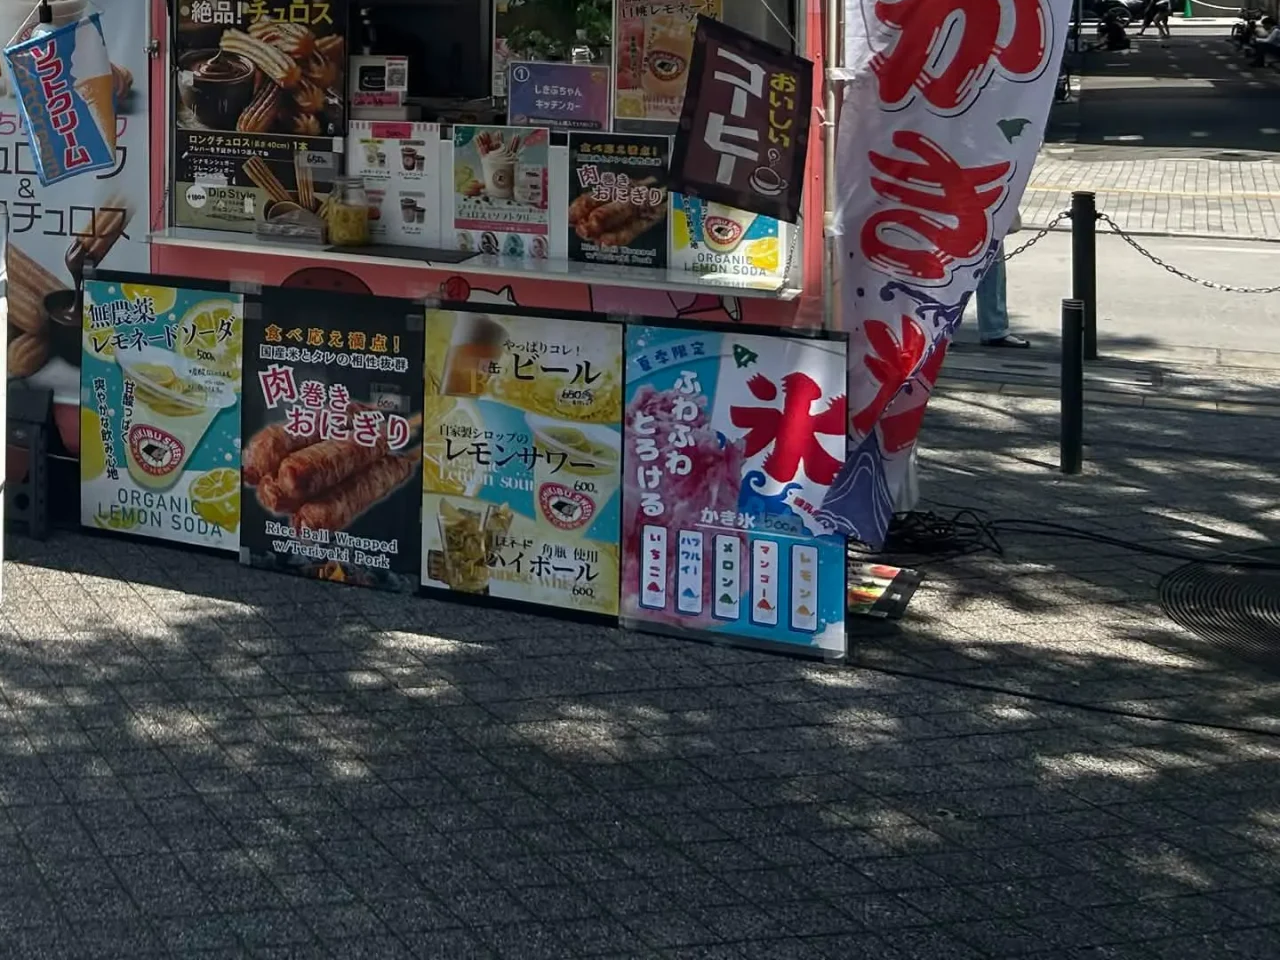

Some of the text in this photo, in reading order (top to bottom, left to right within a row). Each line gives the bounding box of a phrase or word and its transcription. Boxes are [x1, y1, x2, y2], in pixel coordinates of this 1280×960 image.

[30, 39, 92, 170] ソフトクリーム
[534, 85, 582, 96] しきぶちゃん
[536, 100, 581, 111] キッチンカー
[704, 47, 767, 185] コーヒー
[768, 72, 797, 148] おいしい
[18, 178, 35, 198] &
[577, 164, 630, 188] 肉巻き
[592, 186, 663, 206] おにぎり
[684, 262, 766, 276] LEMON SODA
[697, 253, 753, 265] ORGANIC
[89, 298, 156, 329] 無農薬
[92, 316, 237, 354] レモネードソーダ
[259, 344, 409, 372] 国産米とタレの相性抜群
[513, 353, 601, 385] ビール
[636, 341, 706, 371] 夏季限定
[258, 363, 351, 413] 肉巻き
[94, 377, 120, 480] 爽やかな飲み心地
[121, 379, 136, 444] 甘酸っぱく
[285, 407, 410, 450] おにぎり
[666, 370, 701, 476] ふわふわ
[440, 424, 528, 444] 自家製シロップの
[730, 371, 846, 487] 氷
[446, 438, 595, 474] レモンサワー
[635, 411, 667, 517] とろける
[117, 488, 200, 516] ORGANIC
[700, 506, 755, 529] かき氷
[98, 502, 223, 538] LEMON SODA
[266, 521, 398, 553] Rice Ball Wrapped
[273, 541, 390, 568] w/Teriyaki Pork
[574, 546, 598, 563] 使用
[649, 533, 662, 578] いちご
[723, 543, 735, 588] メロン
[759, 545, 770, 598] マンゴー
[799, 551, 811, 600] レモン
